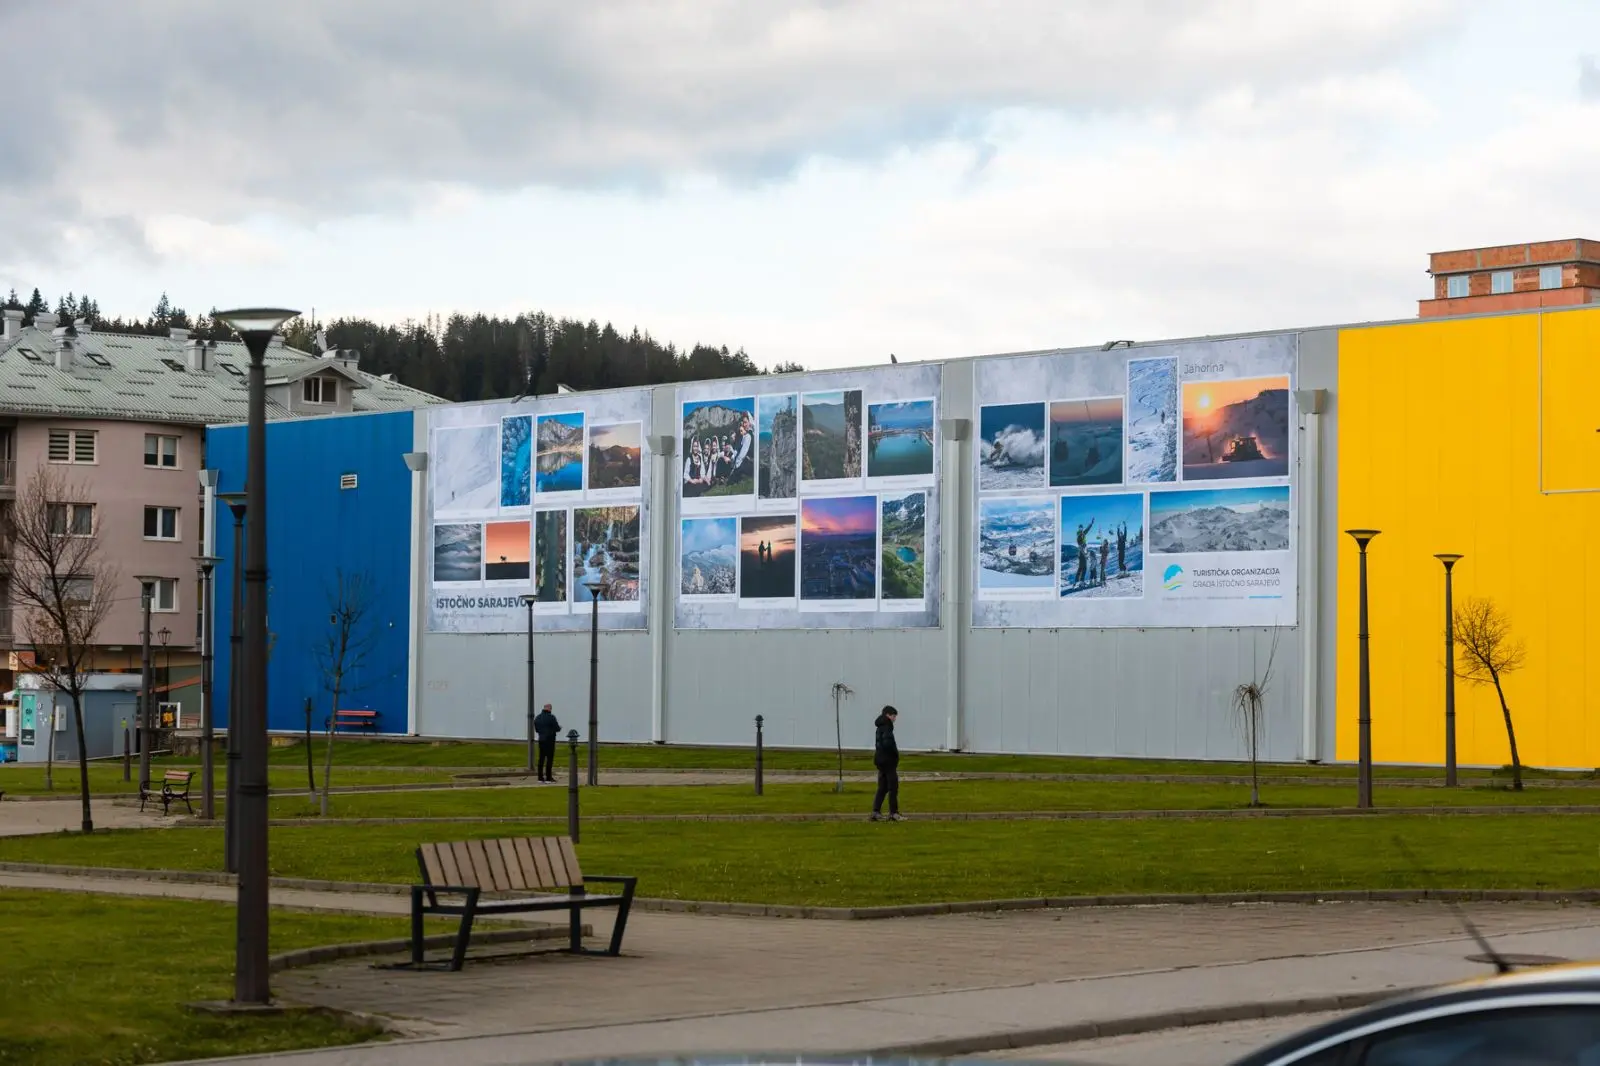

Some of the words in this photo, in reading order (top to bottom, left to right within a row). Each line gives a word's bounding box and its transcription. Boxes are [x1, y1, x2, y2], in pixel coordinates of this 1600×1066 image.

[1184, 362, 1224, 374] Jahorina
[1192, 568, 1230, 577] TURISTIČKA
[1231, 567, 1280, 576] ORGANIZACIJA
[1192, 580, 1215, 588] GRADA
[1246, 579, 1280, 587] SARAJEVO
[436, 594, 476, 608] ISTOČNO
[477, 597, 527, 608] SARAJEVO
